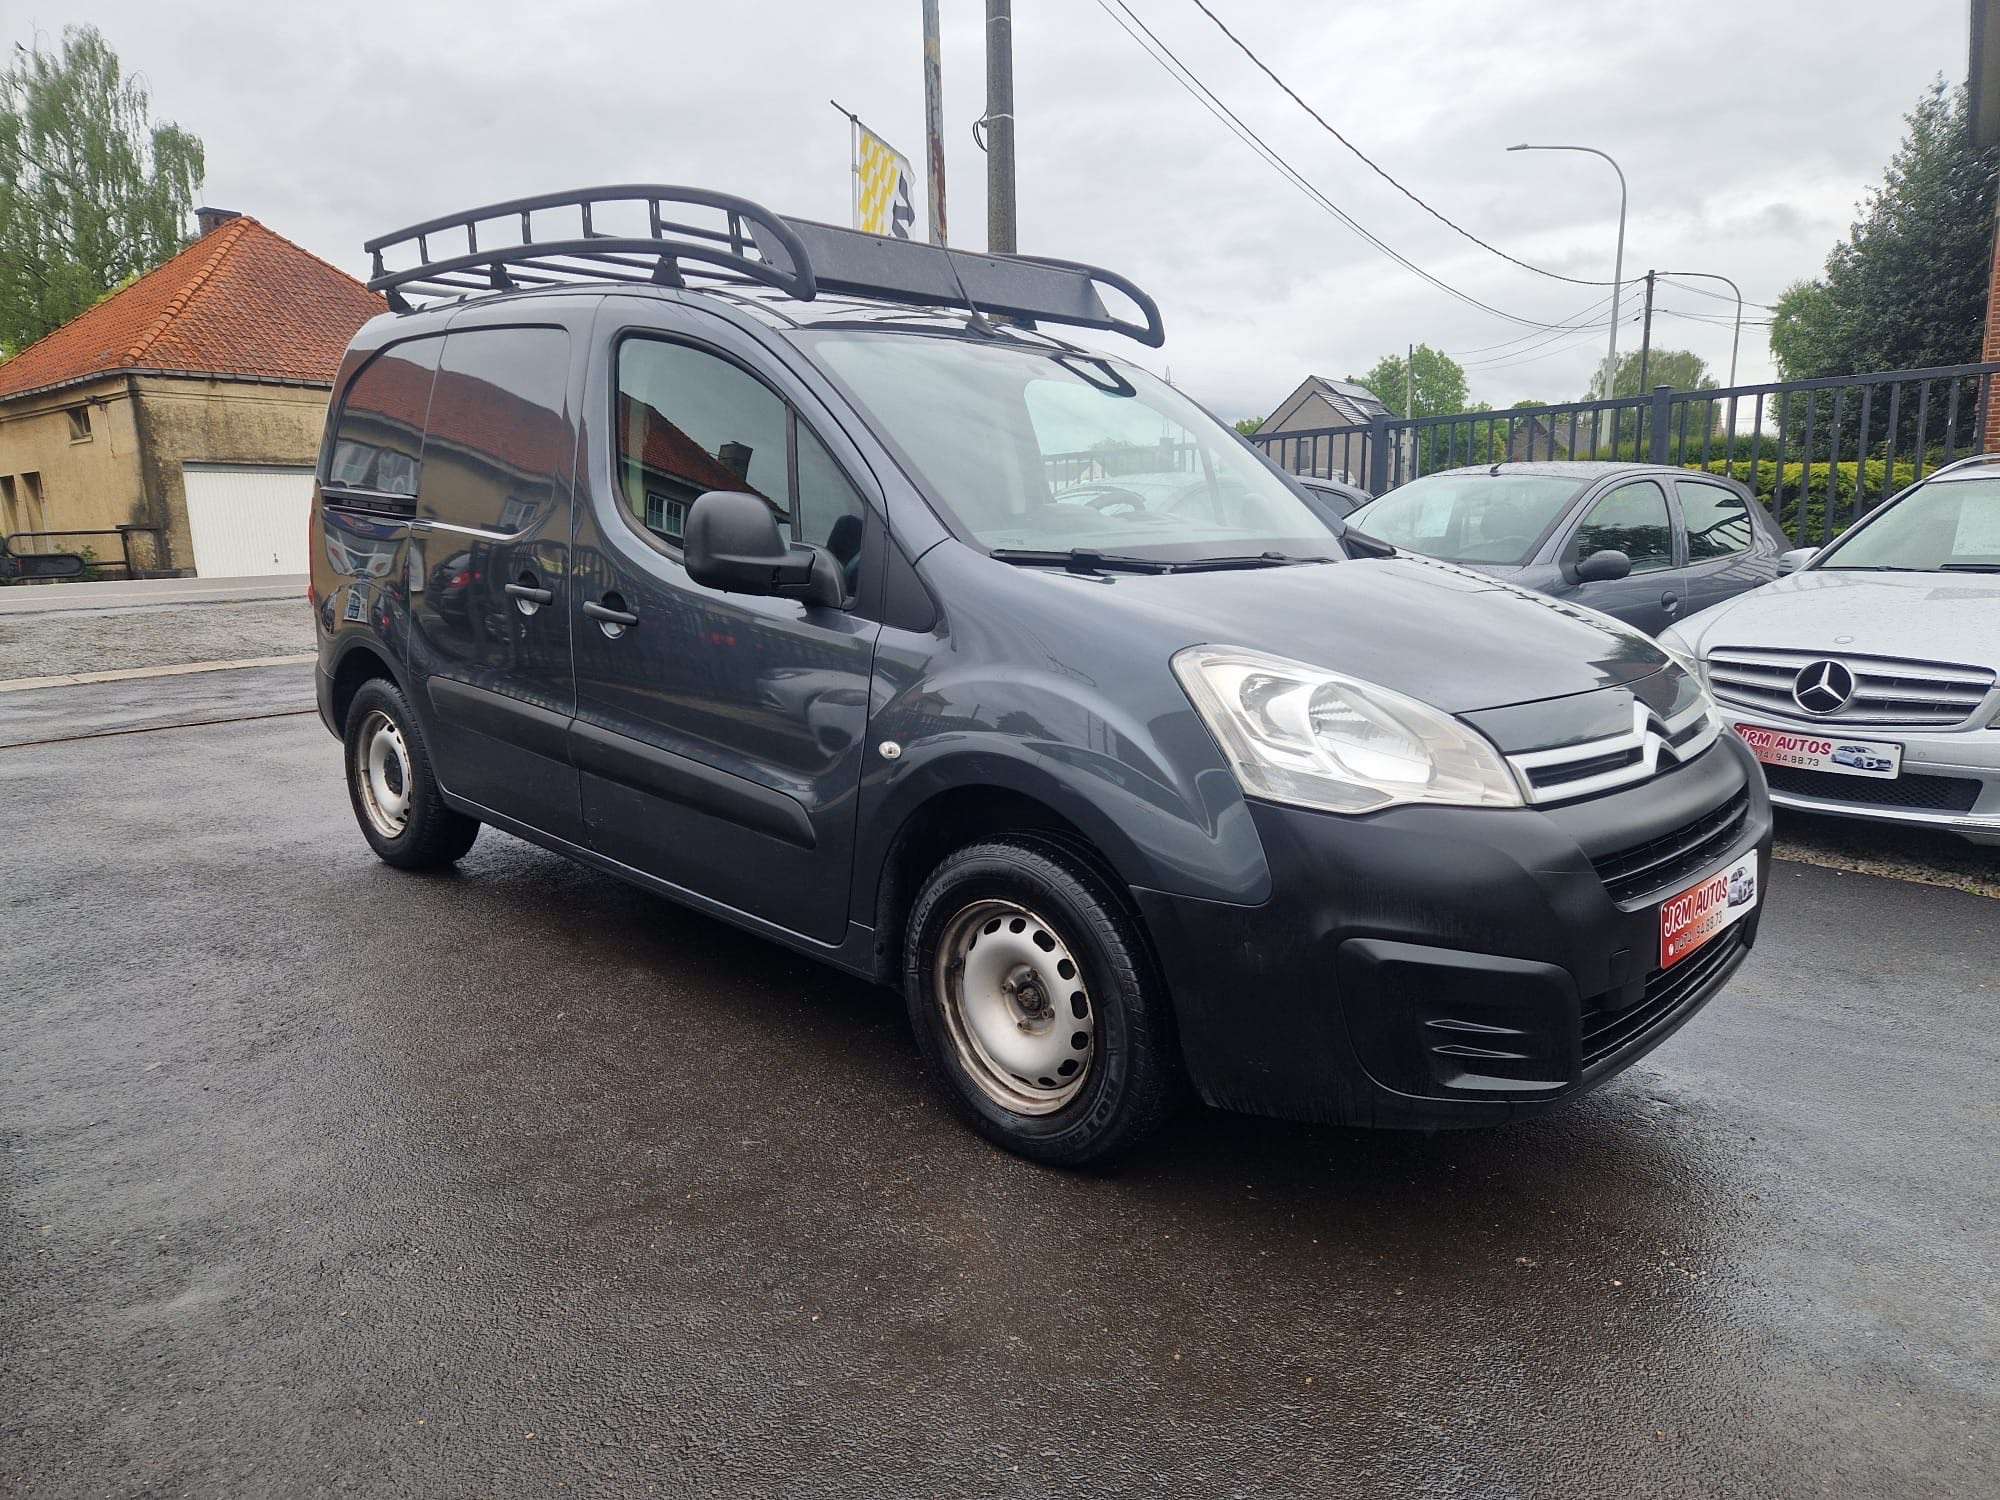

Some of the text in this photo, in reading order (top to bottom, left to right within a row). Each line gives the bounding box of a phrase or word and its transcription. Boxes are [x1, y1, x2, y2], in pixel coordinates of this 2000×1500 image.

[1775, 735, 1832, 756] AUTOS
[1775, 752, 1820, 767] 94.88.73
[1664, 875, 1728, 938] JRM AUTOS
